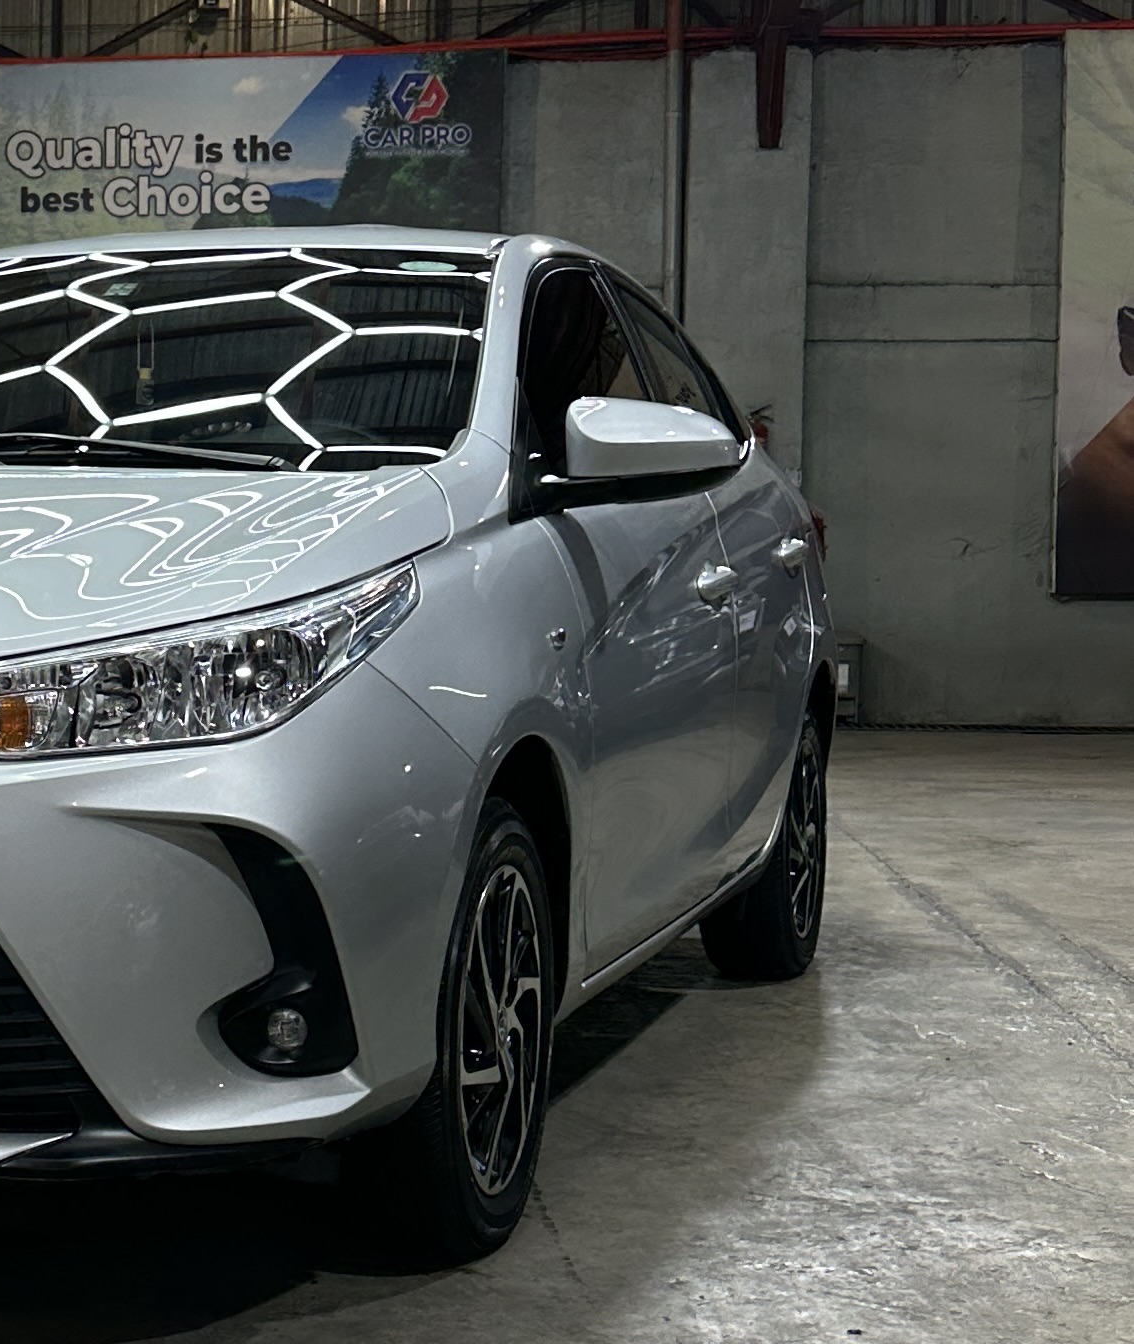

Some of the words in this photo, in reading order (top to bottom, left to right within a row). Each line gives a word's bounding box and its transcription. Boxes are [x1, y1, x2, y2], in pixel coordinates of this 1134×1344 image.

[5, 123, 184, 179] Quality
[195, 134, 223, 164] is
[233, 135, 293, 163] the
[364, 127, 413, 147] CAR
[421, 125, 471, 146] PRO
[20, 186, 94, 213] best
[102, 170, 271, 217] Choice
